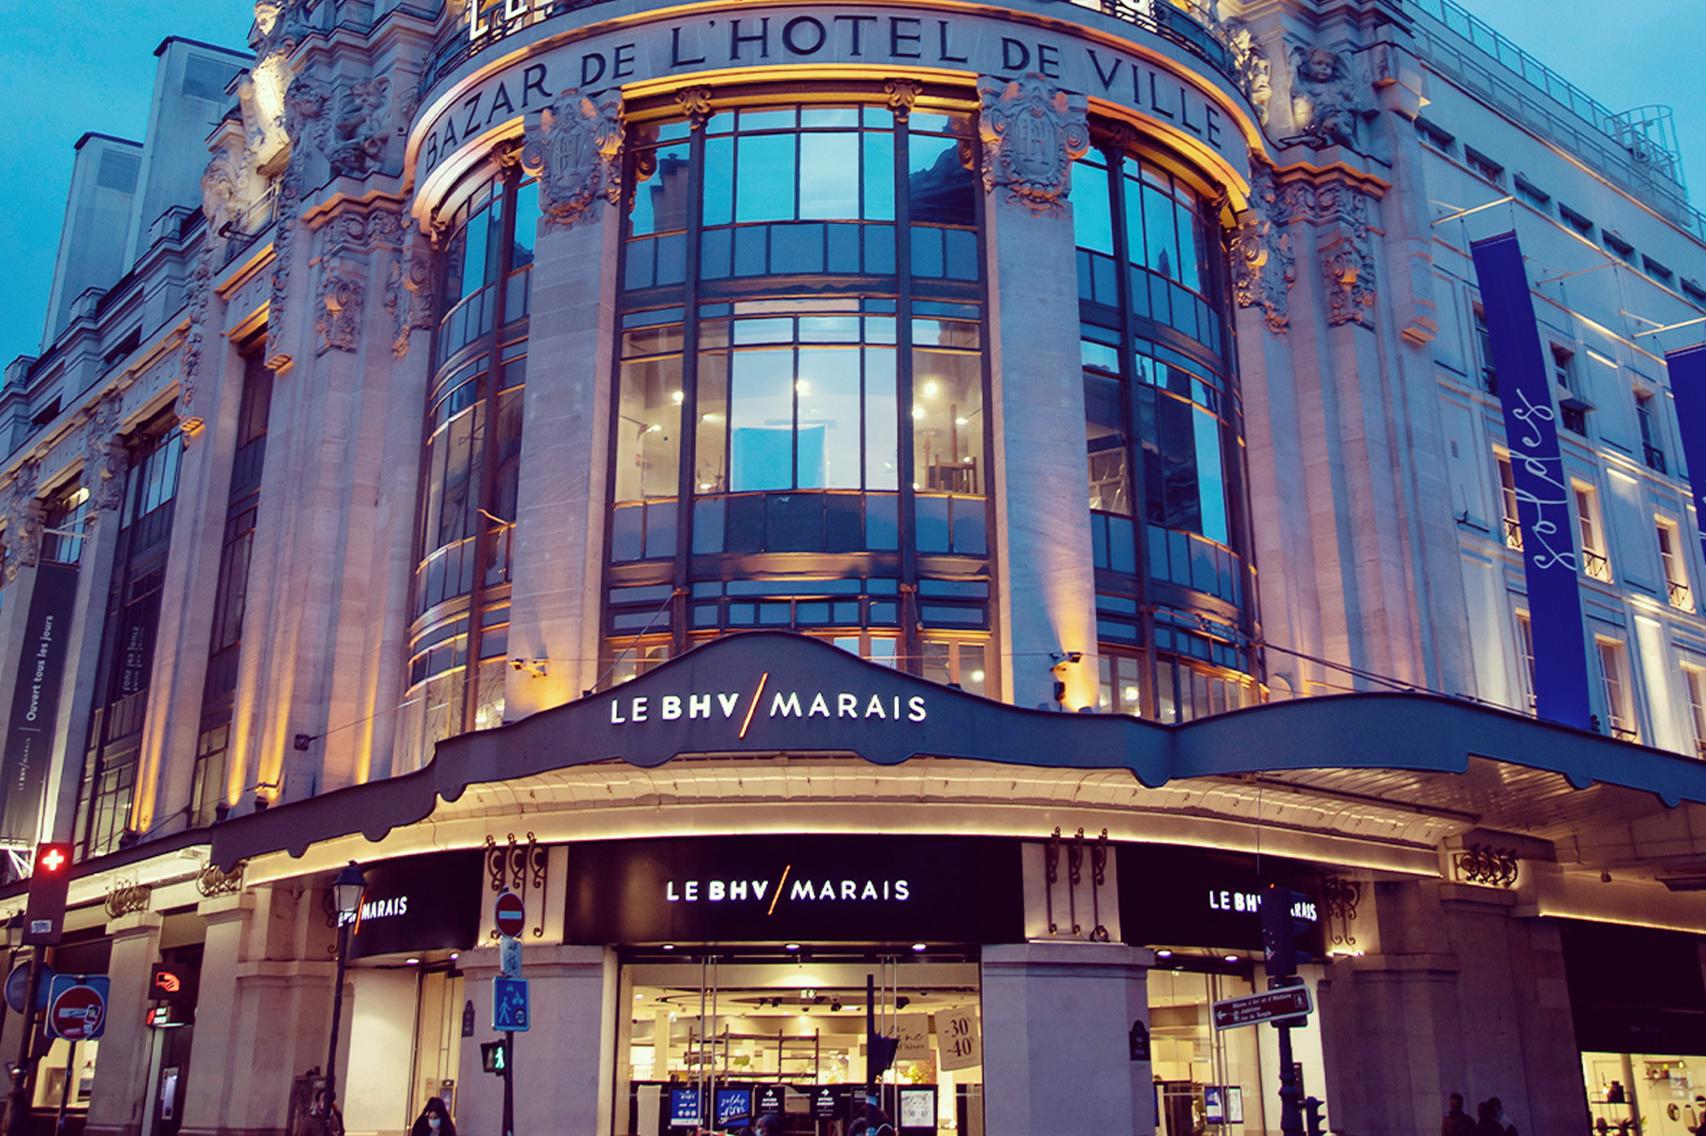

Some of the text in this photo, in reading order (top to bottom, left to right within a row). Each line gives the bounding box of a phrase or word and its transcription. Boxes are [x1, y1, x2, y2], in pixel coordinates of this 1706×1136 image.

[425, 63, 553, 174] BAZAR
[580, 43, 636, 88] DE
[670, 15, 968, 69] L'HOTEL
[1001, 36, 1060, 79] DE
[1086, 48, 1222, 150] VILLE
[1509, 388, 1578, 572] soldes
[26, 615, 54, 721] Ouvert tous les jours
[610, 696, 649, 724] LE
[661, 692, 740, 720] BHV
[769, 692, 927, 722] MARAIS
[667, 880, 699, 901] LE
[708, 880, 769, 901] BHV
[790, 880, 910, 901] MARAIS
[1209, 890, 1231, 910] LE
[361, 896, 408, 920] MARAIS
